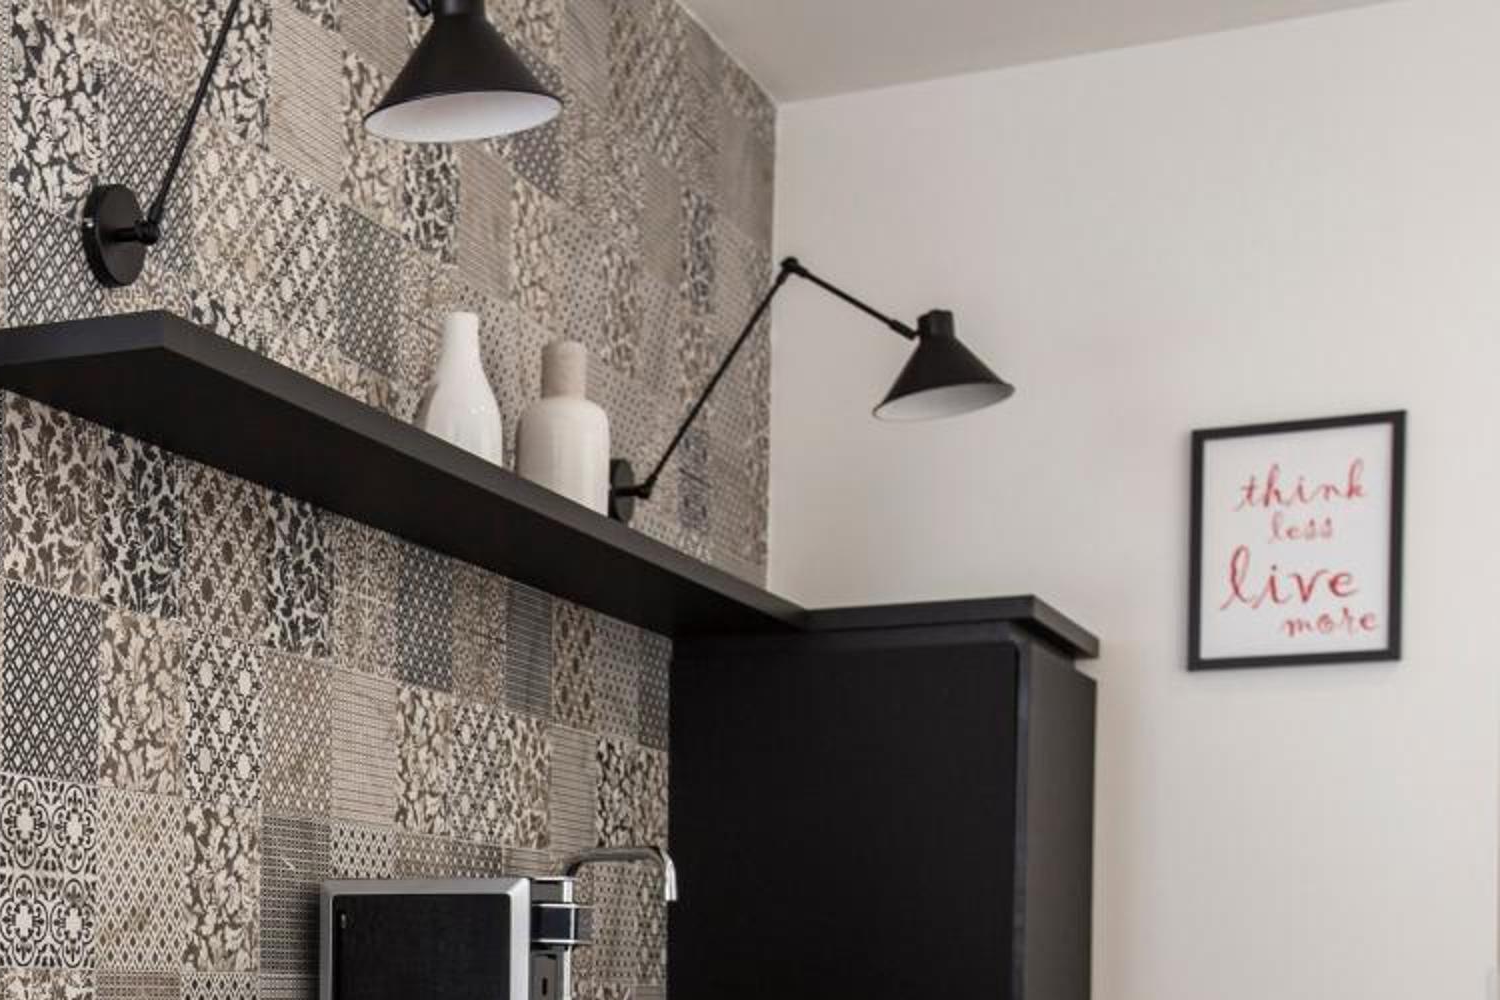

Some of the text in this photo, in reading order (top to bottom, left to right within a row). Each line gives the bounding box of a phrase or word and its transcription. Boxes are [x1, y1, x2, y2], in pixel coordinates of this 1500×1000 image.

[1232, 458, 1367, 512] think
[1269, 512, 1334, 544] less
[1220, 544, 1358, 610] live
[1283, 608, 1378, 637] more
